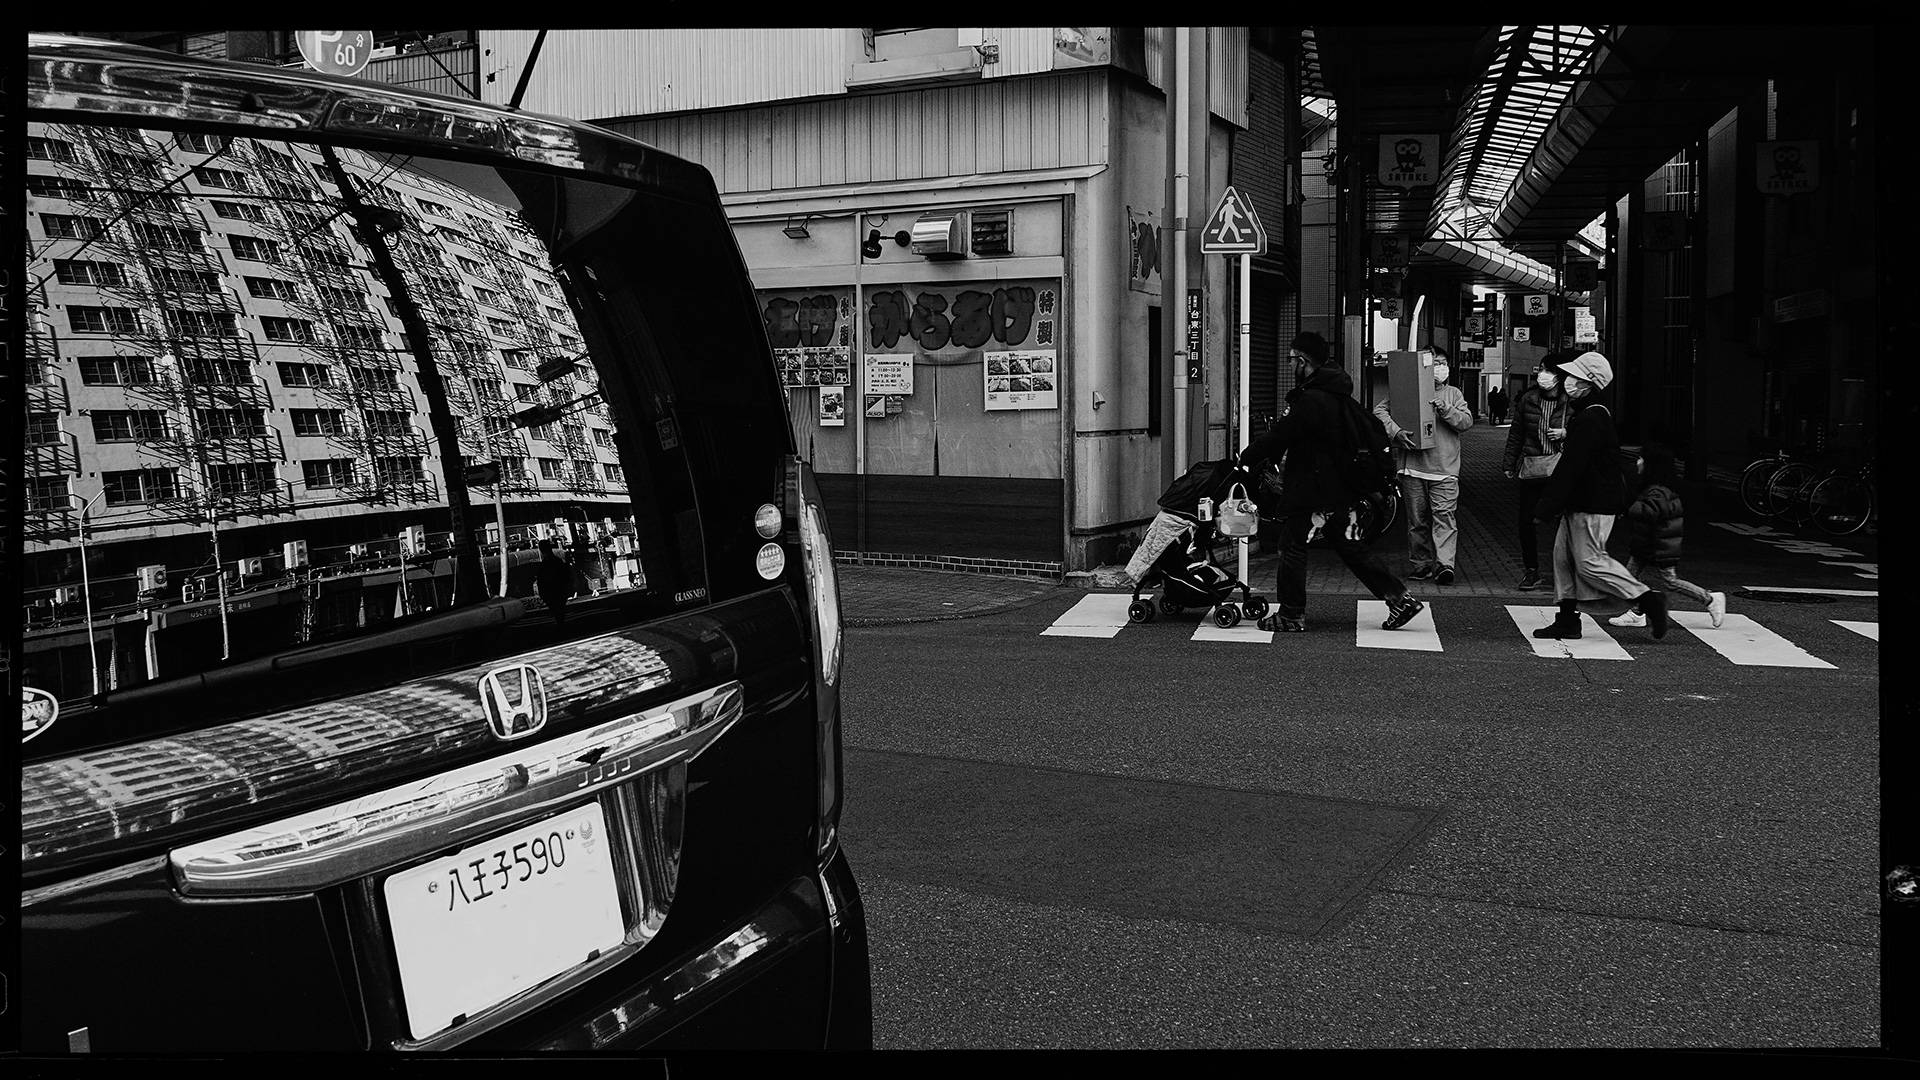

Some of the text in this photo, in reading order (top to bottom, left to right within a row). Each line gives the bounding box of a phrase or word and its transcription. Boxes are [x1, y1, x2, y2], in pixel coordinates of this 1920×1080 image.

[1388, 173, 1428, 181] SATAKE
[1766, 180, 1809, 189] SATAKE
[868, 286, 1036, 350] からあげ
[1036, 290, 1055, 346] 特製
[1190, 310, 1199, 360] 台東三丁目
[1191, 367, 1198, 378] 2
[675, 587, 706, 603] GLASS NEO
